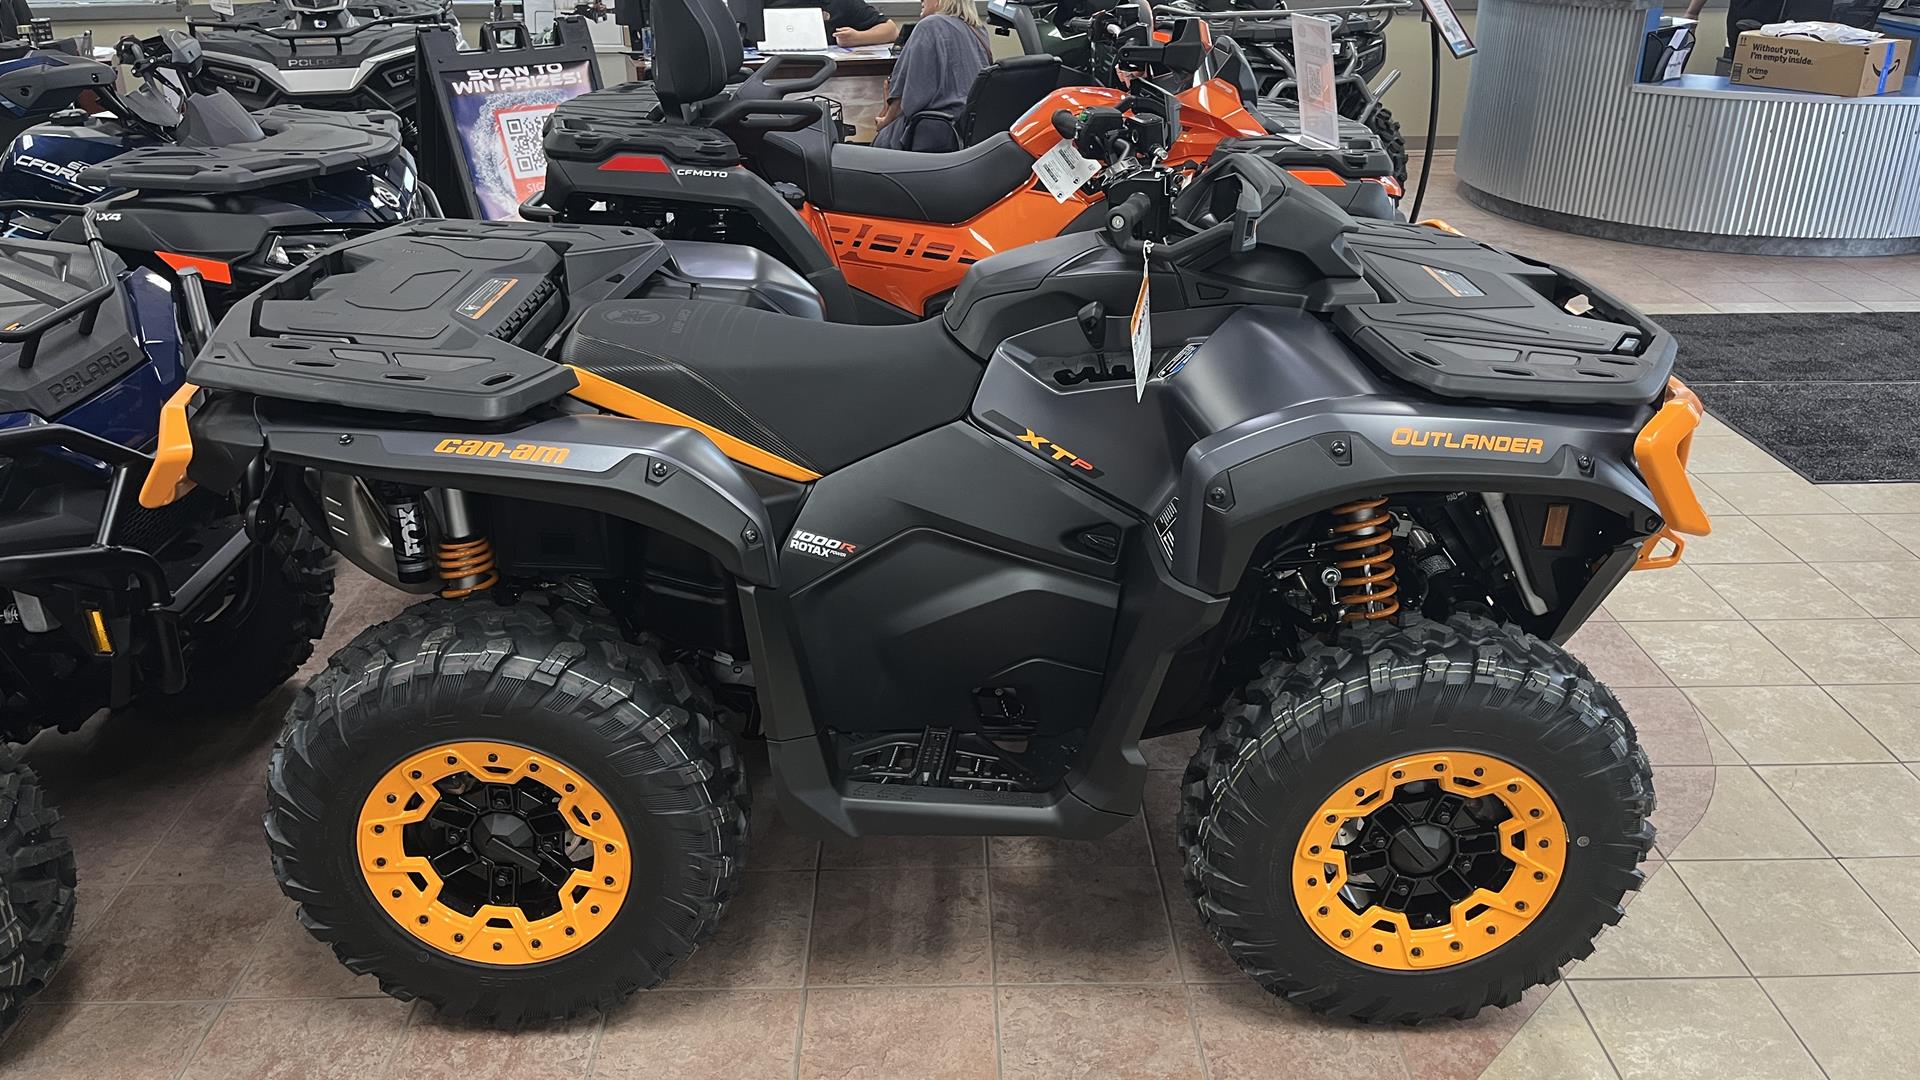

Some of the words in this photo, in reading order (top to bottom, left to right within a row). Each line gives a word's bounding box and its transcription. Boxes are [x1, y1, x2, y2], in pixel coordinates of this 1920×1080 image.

[1750, 51, 1762, 60] I'm
[1763, 53, 1788, 63] empty
[1788, 55, 1814, 66] inside.
[1752, 43, 1784, 54] Without
[1784, 46, 1801, 56] you,
[287, 58, 346, 67] POLAR
[466, 65, 530, 81] SCAN
[533, 62, 563, 75] TO
[1746, 66, 1769, 75] prime
[451, 79, 495, 95] WIN
[500, 71, 583, 91] PRIZES!
[676, 169, 729, 178] CFMOTO
[95, 212, 122, 221] X4
[47, 346, 130, 402] POLARIS
[1391, 426, 1544, 455] OUTLANDER
[433, 438, 570, 465] can-am
[398, 507, 422, 557] FOX
[790, 539, 830, 558] ROTAX
[793, 530, 857, 554] 1000R
